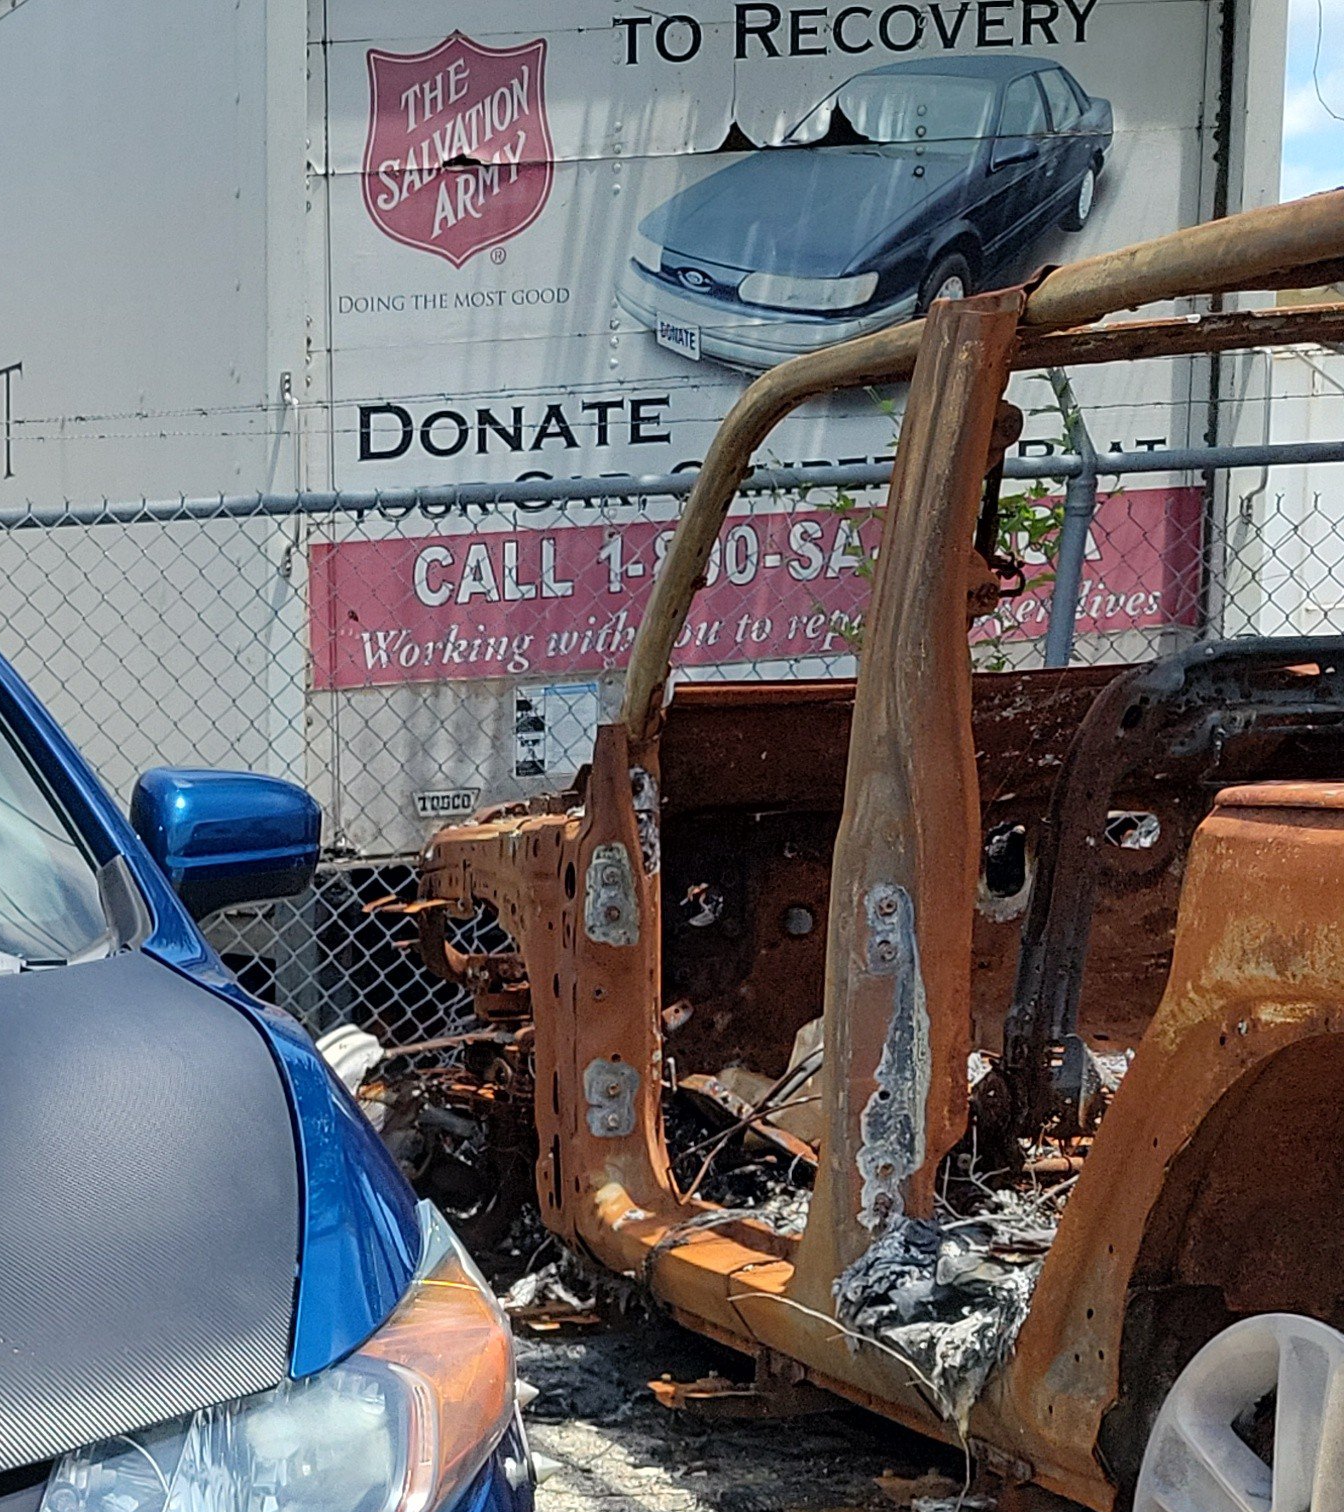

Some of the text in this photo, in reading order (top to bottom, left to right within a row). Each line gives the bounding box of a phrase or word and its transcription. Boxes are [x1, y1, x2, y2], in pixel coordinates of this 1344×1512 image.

[612, 0, 1099, 66] TO RECOVERY
[400, 58, 470, 134] THE
[377, 65, 530, 211] SALVATION
[430, 130, 527, 240] ARMY
[338, 287, 570, 313] DOING THE MOST GOOD
[358, 393, 671, 461] DONATE
[413, 537, 574, 607] CALL
[362, 624, 535, 673] Working
[547, 610, 635, 657] with
[735, 613, 772, 643] to
